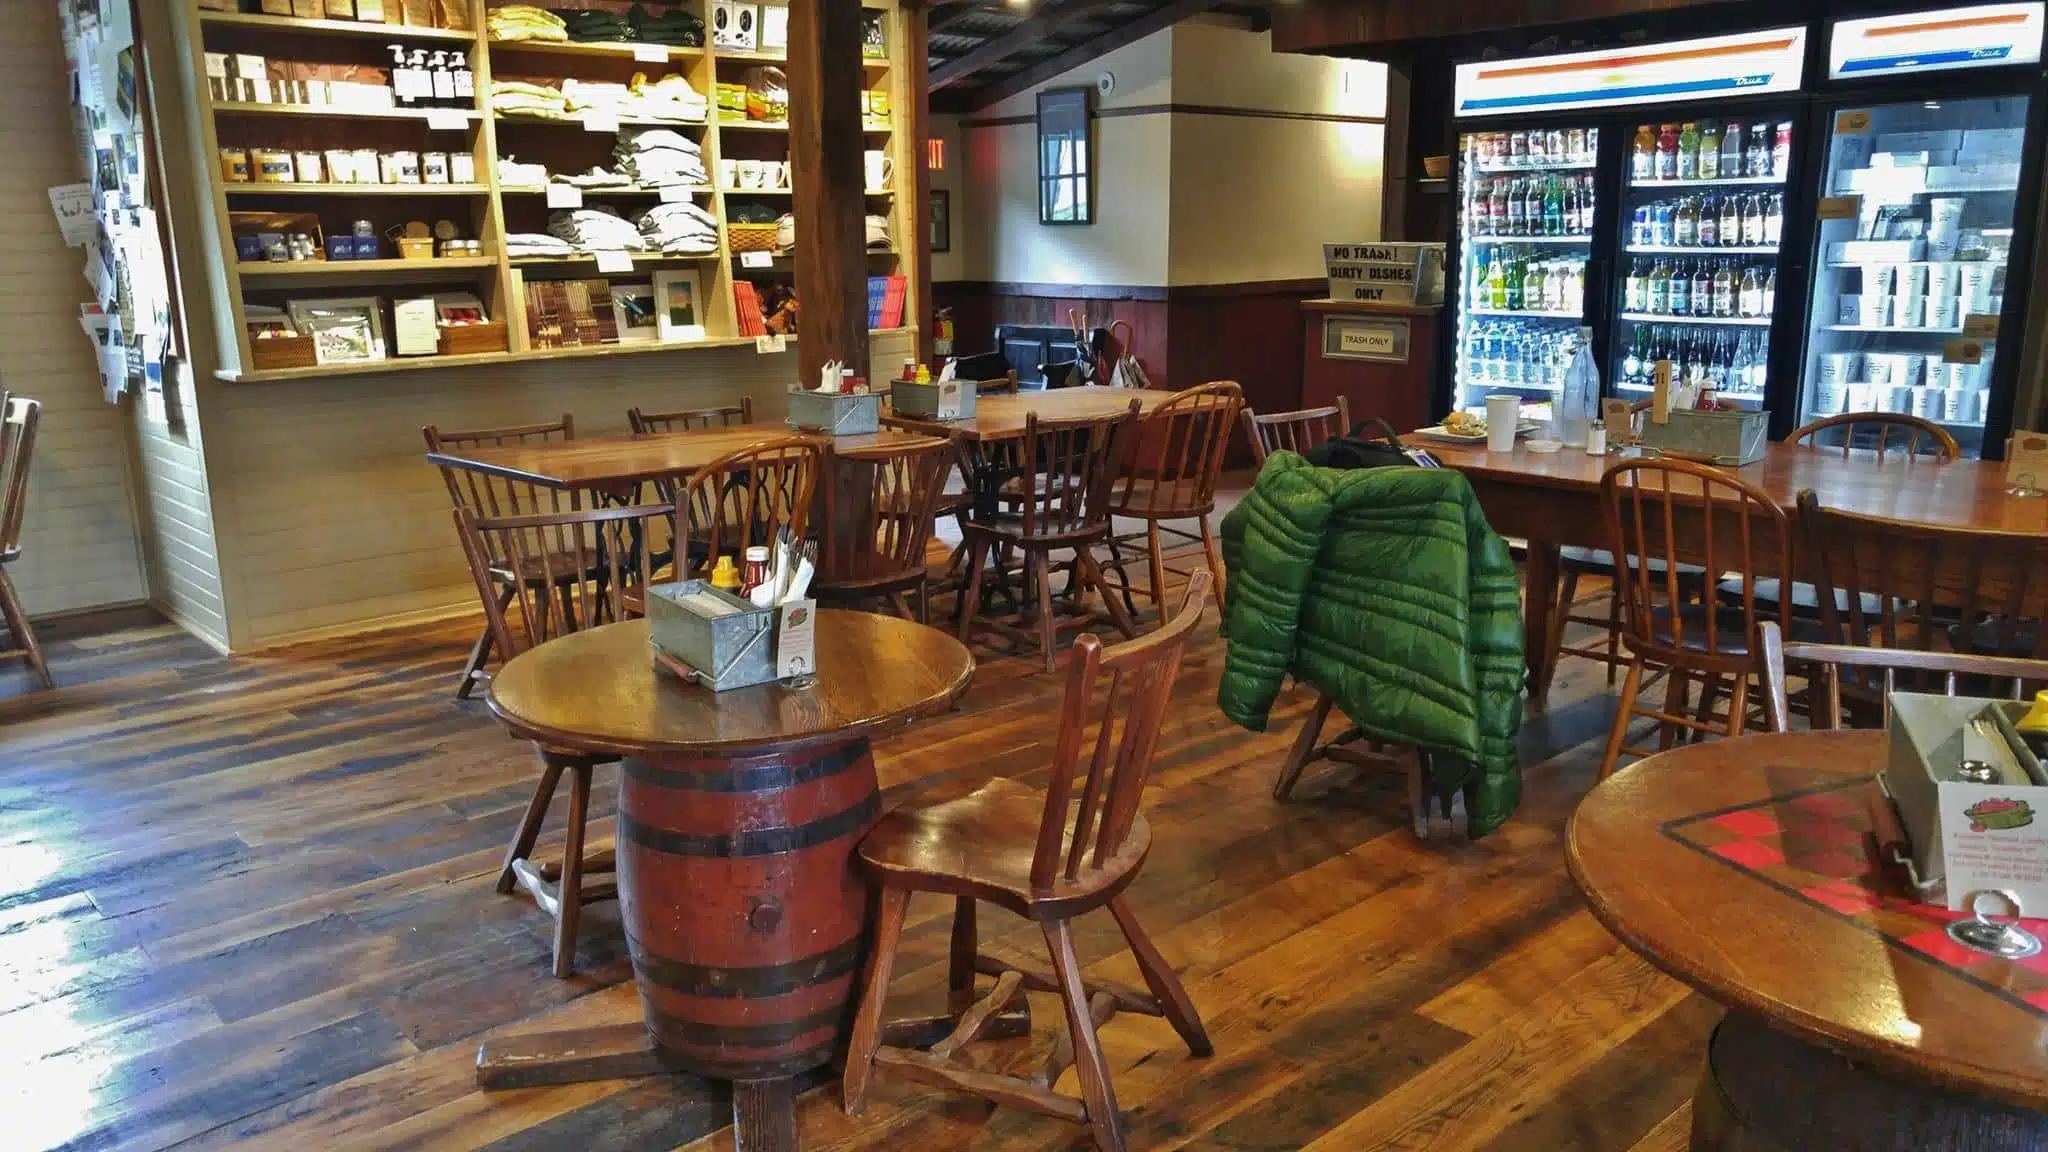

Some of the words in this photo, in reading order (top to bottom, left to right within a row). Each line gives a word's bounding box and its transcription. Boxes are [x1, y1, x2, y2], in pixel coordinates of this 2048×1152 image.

[1334, 247, 1349, 259] NO
[1331, 267, 1363, 280] DIRTY
[1369, 267, 1412, 281] DISHES
[1355, 288, 1384, 300] ONLY
[1344, 336, 1367, 345] TRASH
[1369, 337, 1389, 346] ONLY
